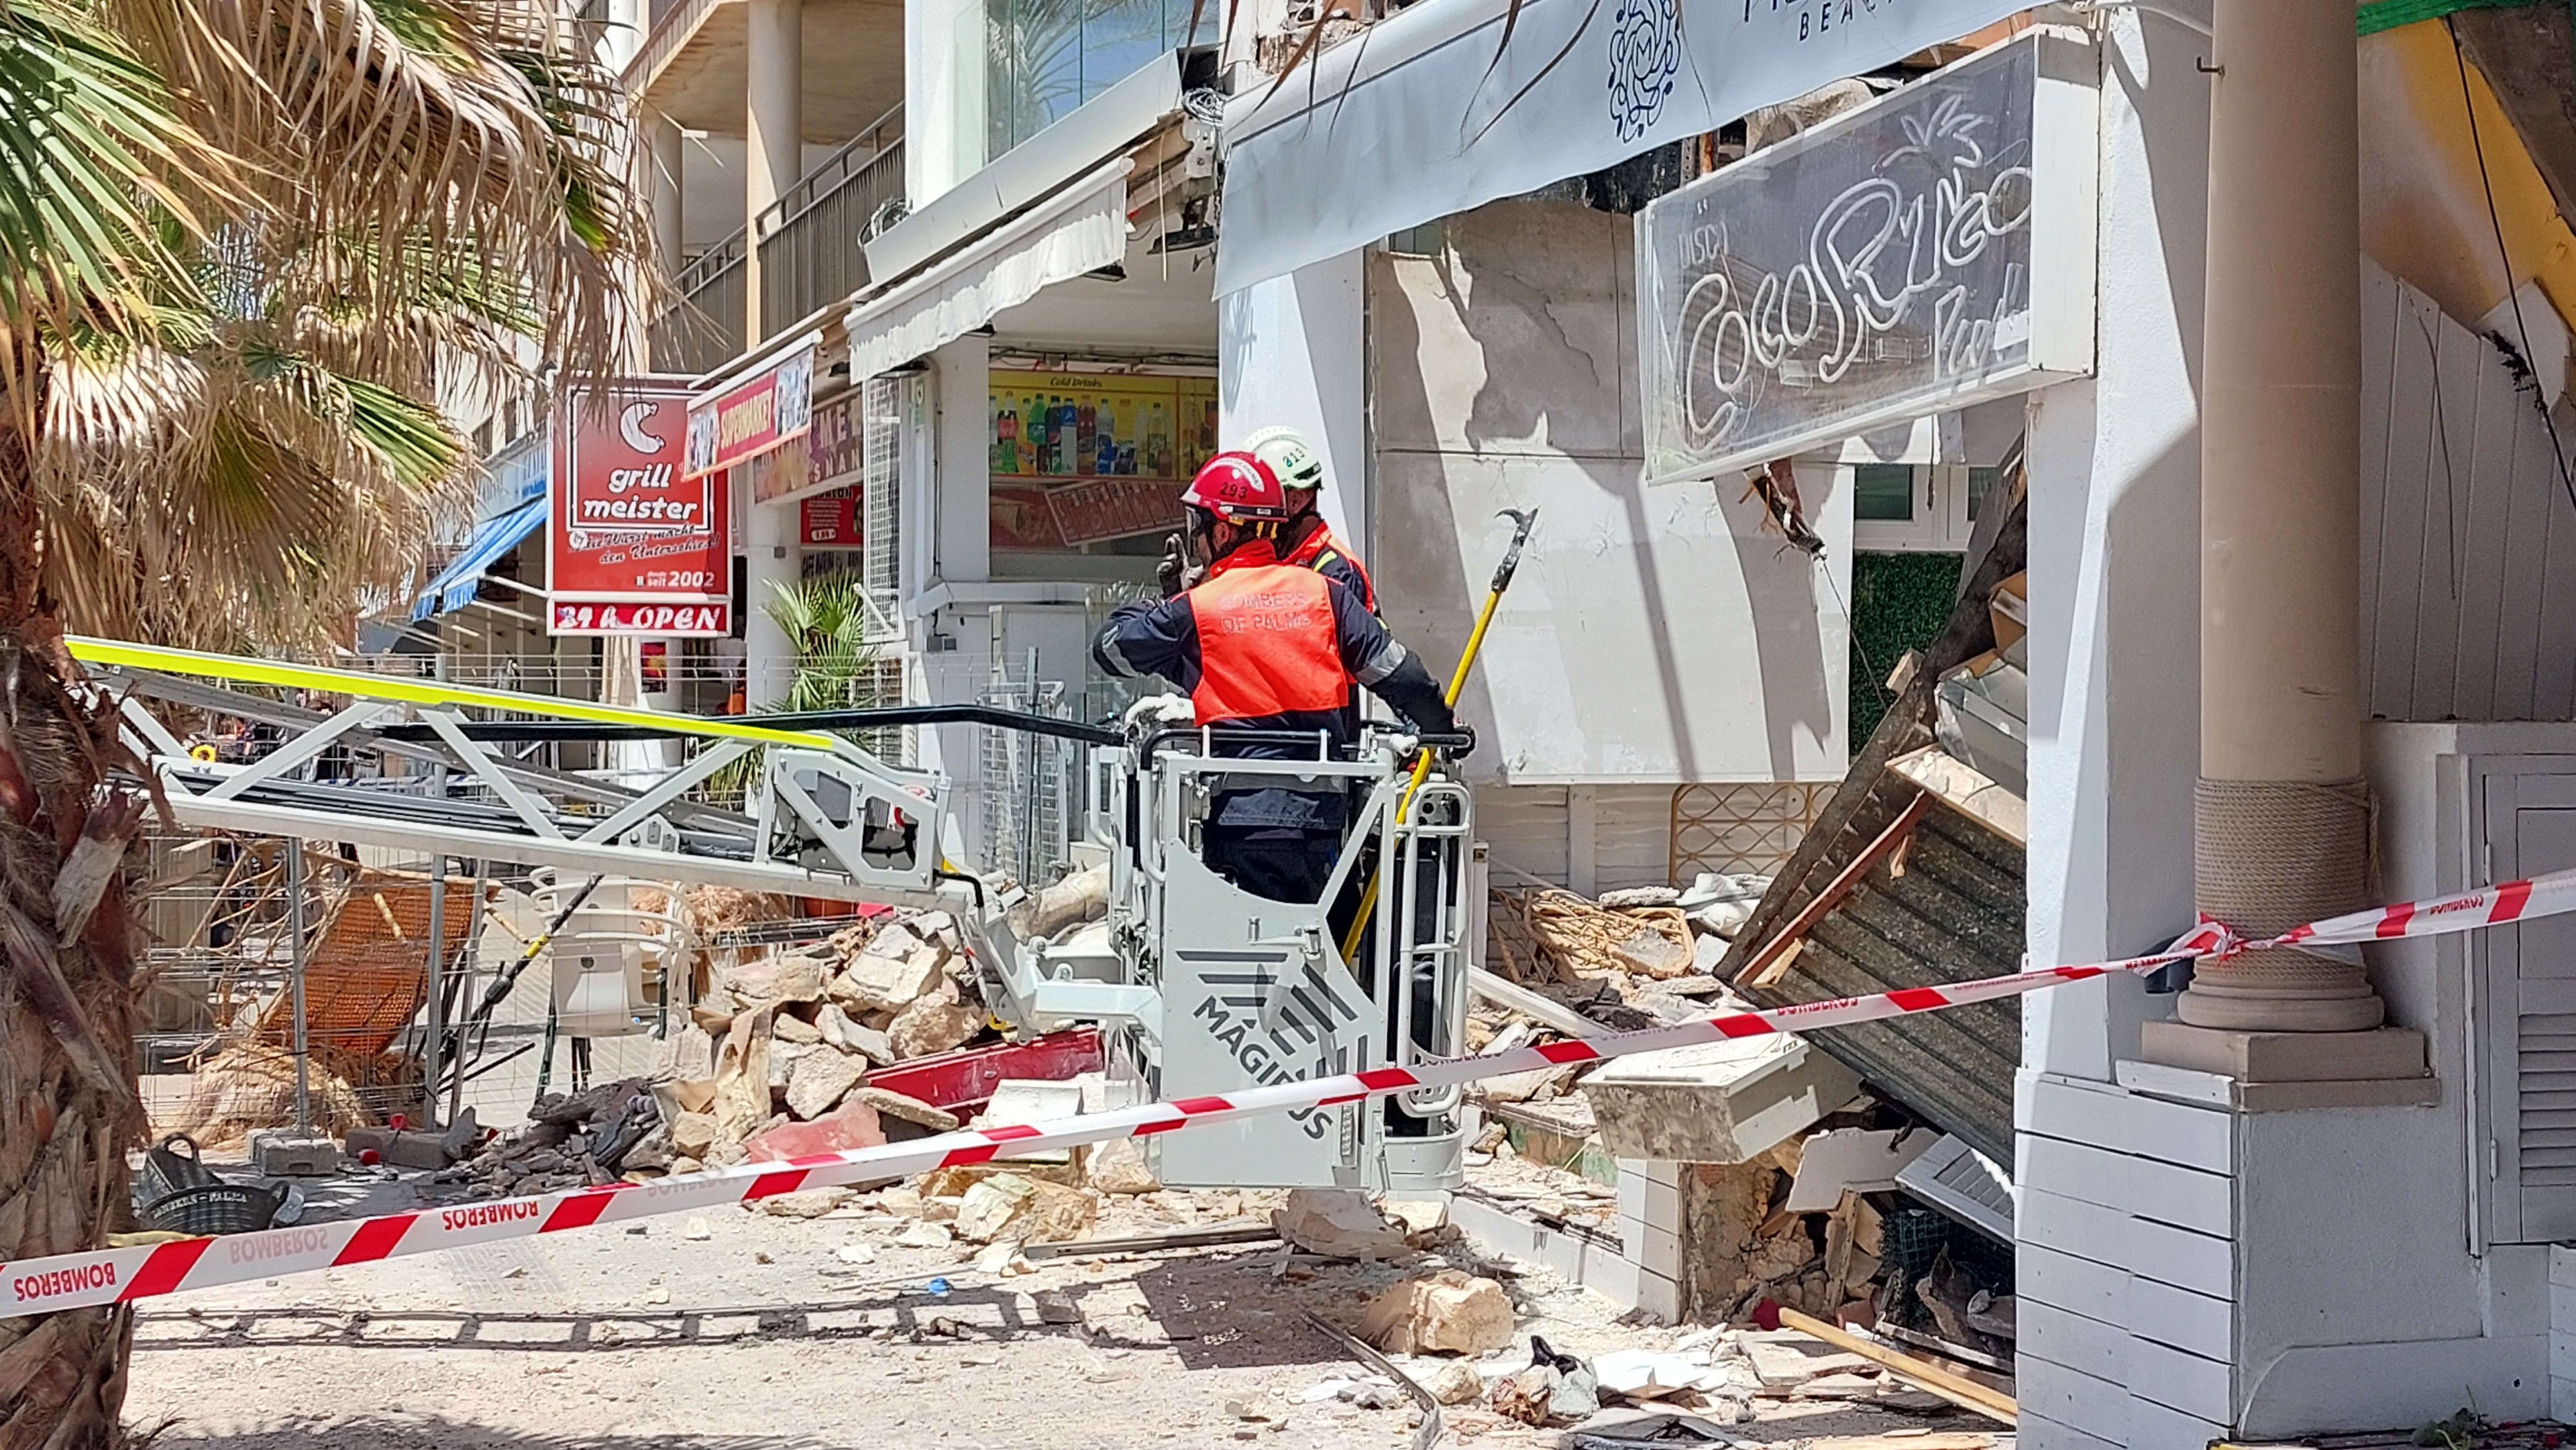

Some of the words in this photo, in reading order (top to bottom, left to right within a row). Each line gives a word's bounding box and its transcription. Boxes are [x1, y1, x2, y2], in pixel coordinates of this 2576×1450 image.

[1051, 377, 1071, 386] Cold
[1072, 378, 1103, 388] Drinks
[720, 387, 773, 451] SUPERMARKET
[608, 463, 674, 493] grill
[1220, 482, 1248, 500] 293
[583, 494, 698, 520] meister
[653, 524, 696, 541] macht
[600, 551, 625, 564] den
[647, 577, 665, 588] seit
[668, 571, 714, 588] 2002
[1219, 592, 1309, 610] BOMBERS
[600, 606, 618, 629] h
[633, 606, 720, 630] OPEN
[1222, 618, 1246, 632] DE
[1253, 612, 1312, 631] PALMA
[442, 1201, 539, 1231] BOMBEROS
[13, 1262, 116, 1302] BOMBEROS
